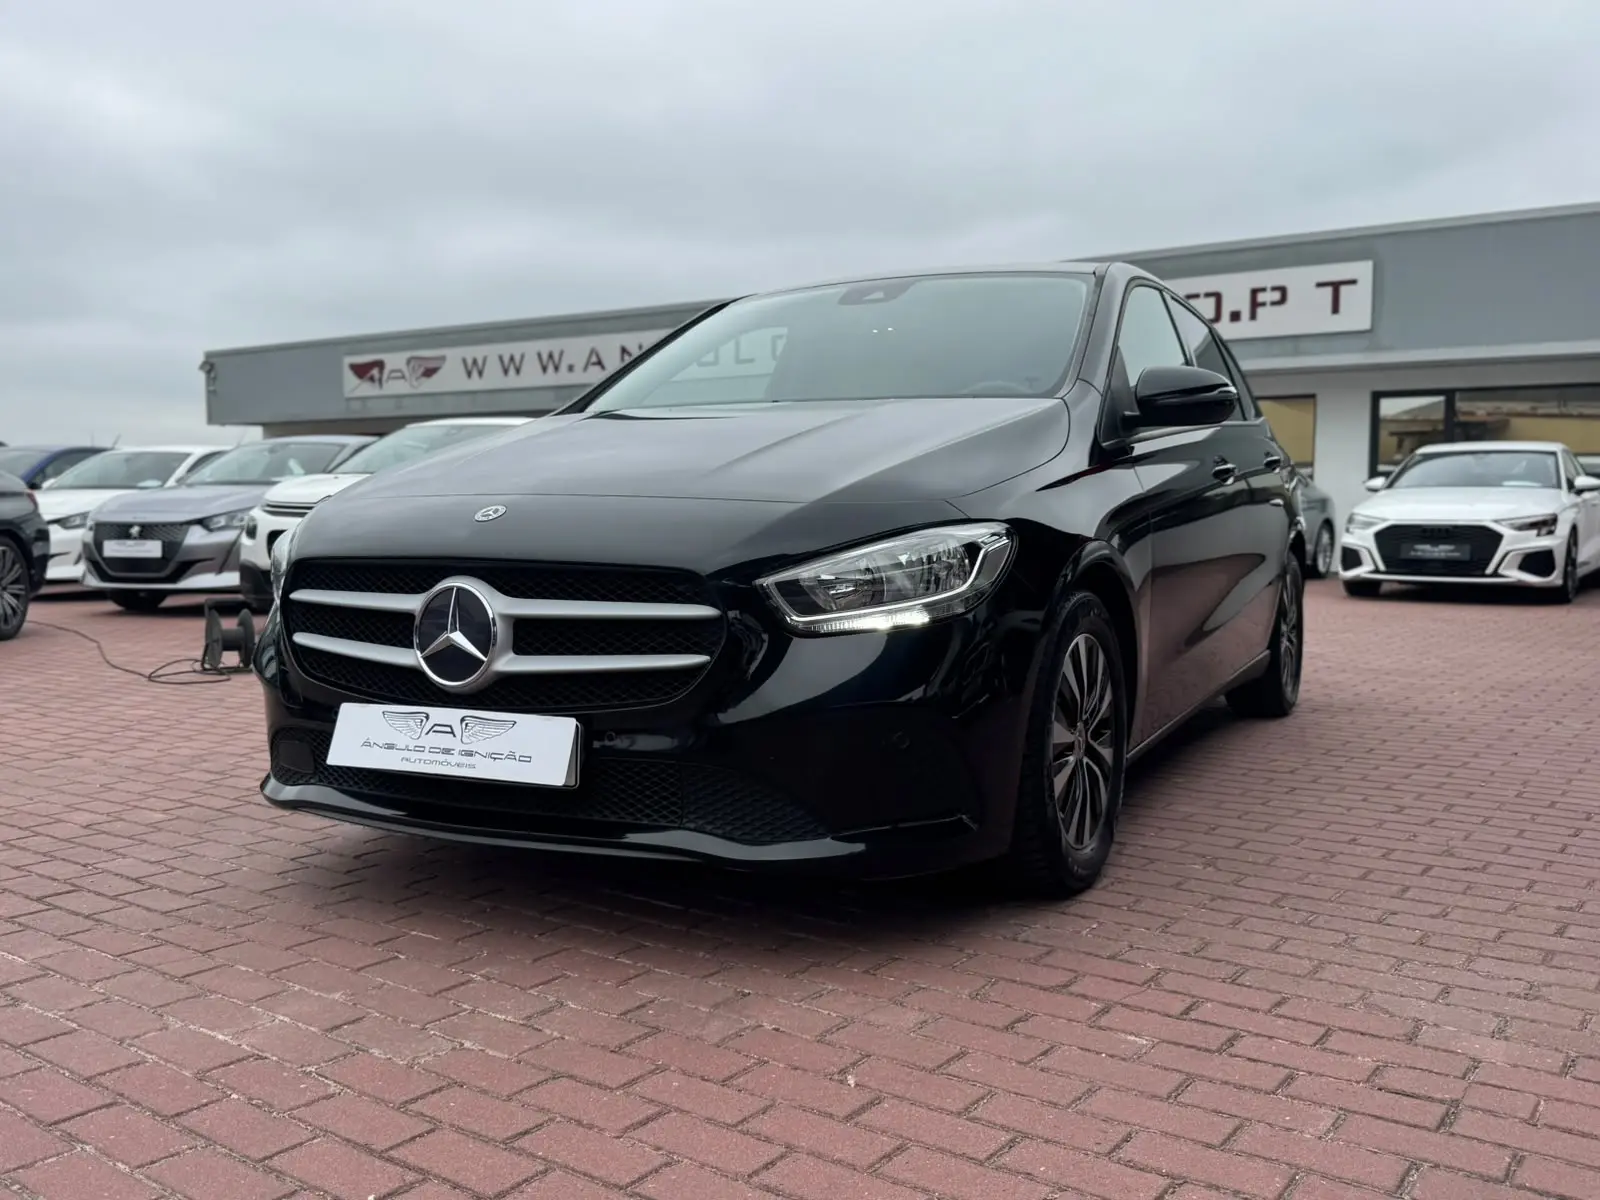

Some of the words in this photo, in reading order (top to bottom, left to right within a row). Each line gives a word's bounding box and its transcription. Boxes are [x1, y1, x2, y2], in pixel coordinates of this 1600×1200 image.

[360, 736, 426, 753] ÁNGULO
[428, 746, 455, 756] DE
[458, 748, 533, 763] IGNIÇÃO
[400, 756, 477, 769] AUTOMÓVEIS
